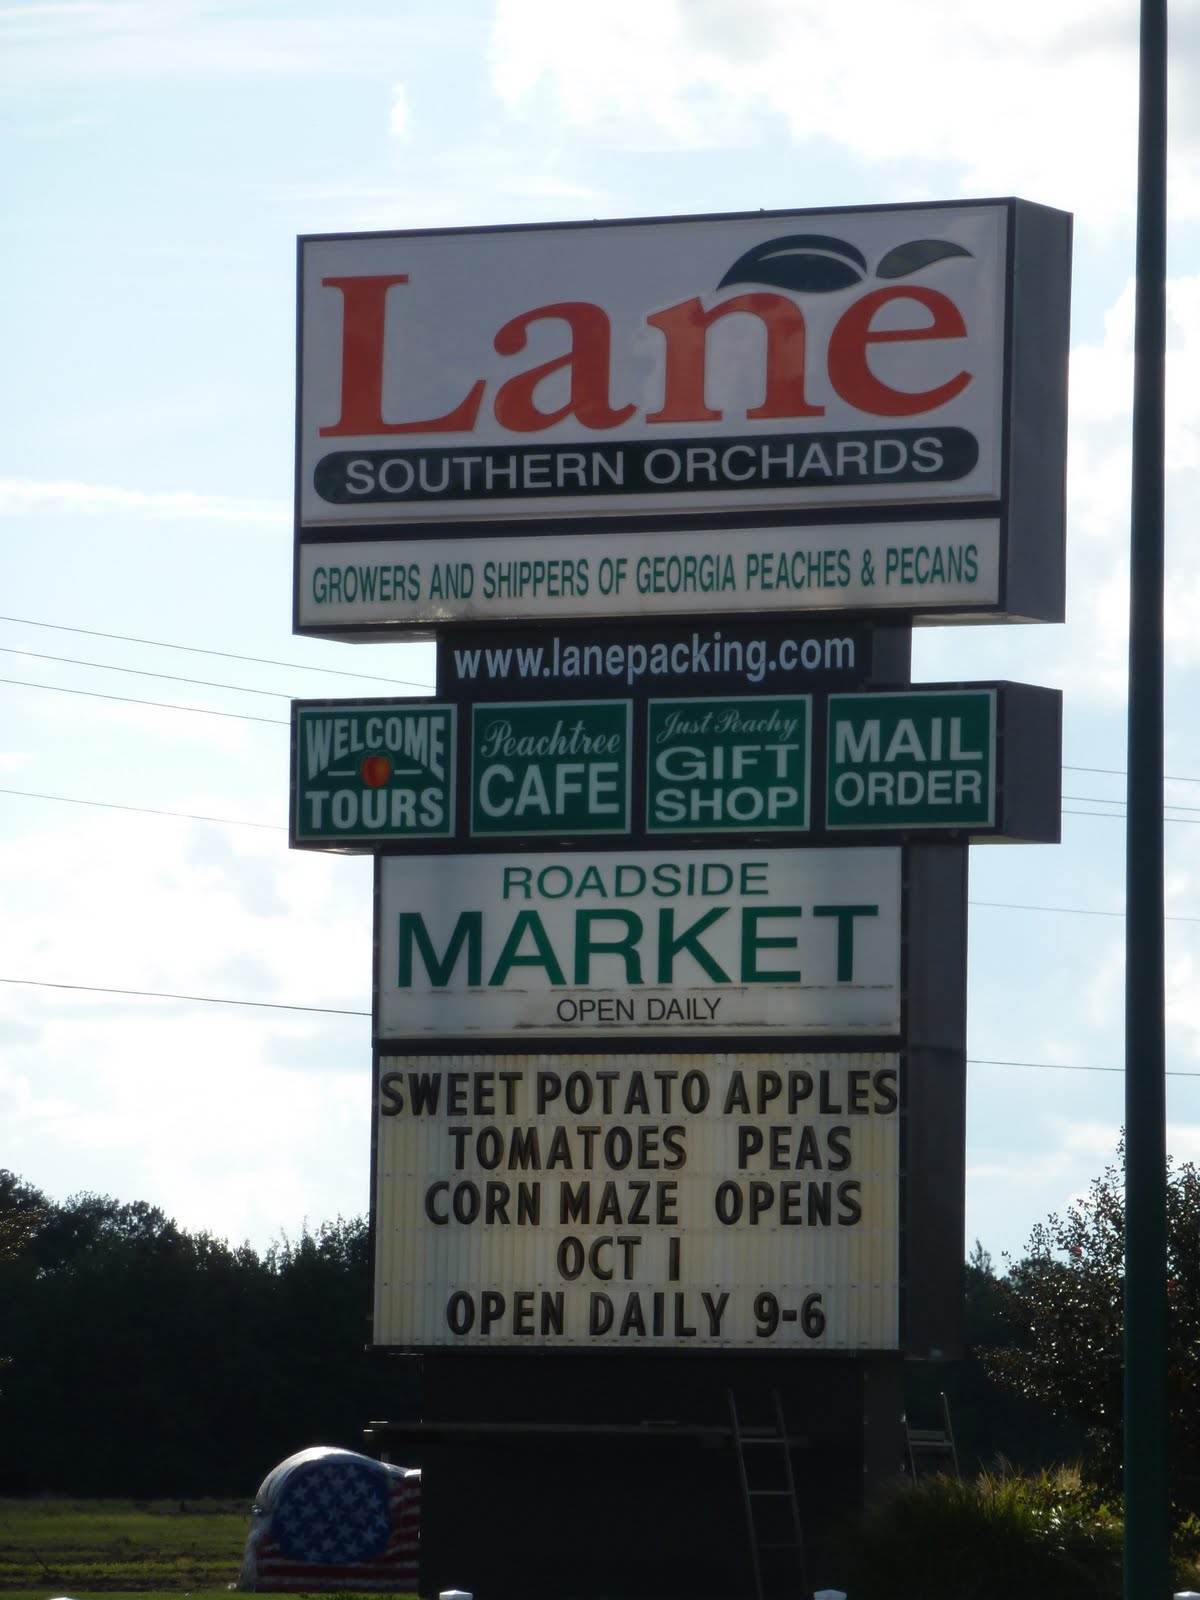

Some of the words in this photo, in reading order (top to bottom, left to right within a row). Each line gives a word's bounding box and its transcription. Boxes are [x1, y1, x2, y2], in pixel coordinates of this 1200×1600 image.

[318, 272, 974, 438] Lane
[344, 450, 626, 497] SOUTHERN
[642, 435, 945, 485] ORCHARDS
[312, 563, 421, 604] GROWERS
[430, 562, 474, 600] AND
[483, 558, 589, 598] SHIPPERS
[599, 557, 628, 594] OF
[636, 553, 737, 593] GEORGIA
[747, 549, 852, 590] PEACHES
[861, 550, 876, 583] &
[886, 544, 979, 584] PECANS
[453, 632, 857, 686] www.lanepacking.com
[305, 715, 447, 781] WELCOME
[480, 720, 621, 760] Peachtree
[655, 710, 705, 744] Just
[711, 709, 800, 741] Peachy
[835, 717, 984, 764] MAIL
[655, 743, 800, 781] GIFT
[305, 786, 445, 830] TOURS
[478, 761, 621, 818] CAFE
[653, 785, 800, 823] SHOP
[834, 769, 982, 808] ORDER
[503, 862, 769, 900] ROADSIDE
[398, 905, 879, 988] MARKET
[556, 999, 635, 1023] OPEN
[647, 997, 721, 1021] DAILY
[380, 1071, 523, 1117] SWEET
[536, 1070, 711, 1115] POTATO
[723, 1069, 899, 1116] APPLES
[448, 1125, 687, 1171] TOMATOES
[738, 1125, 853, 1172] PEAS
[424, 1180, 541, 1226] CORN
[559, 1180, 679, 1225] MAZE
[714, 1180, 863, 1226] OPENS
[556, 1235, 643, 1281] OCT
[446, 1290, 565, 1336] OPEN
[589, 1291, 731, 1337] DAILY
[753, 1292, 826, 1338] 9-6
